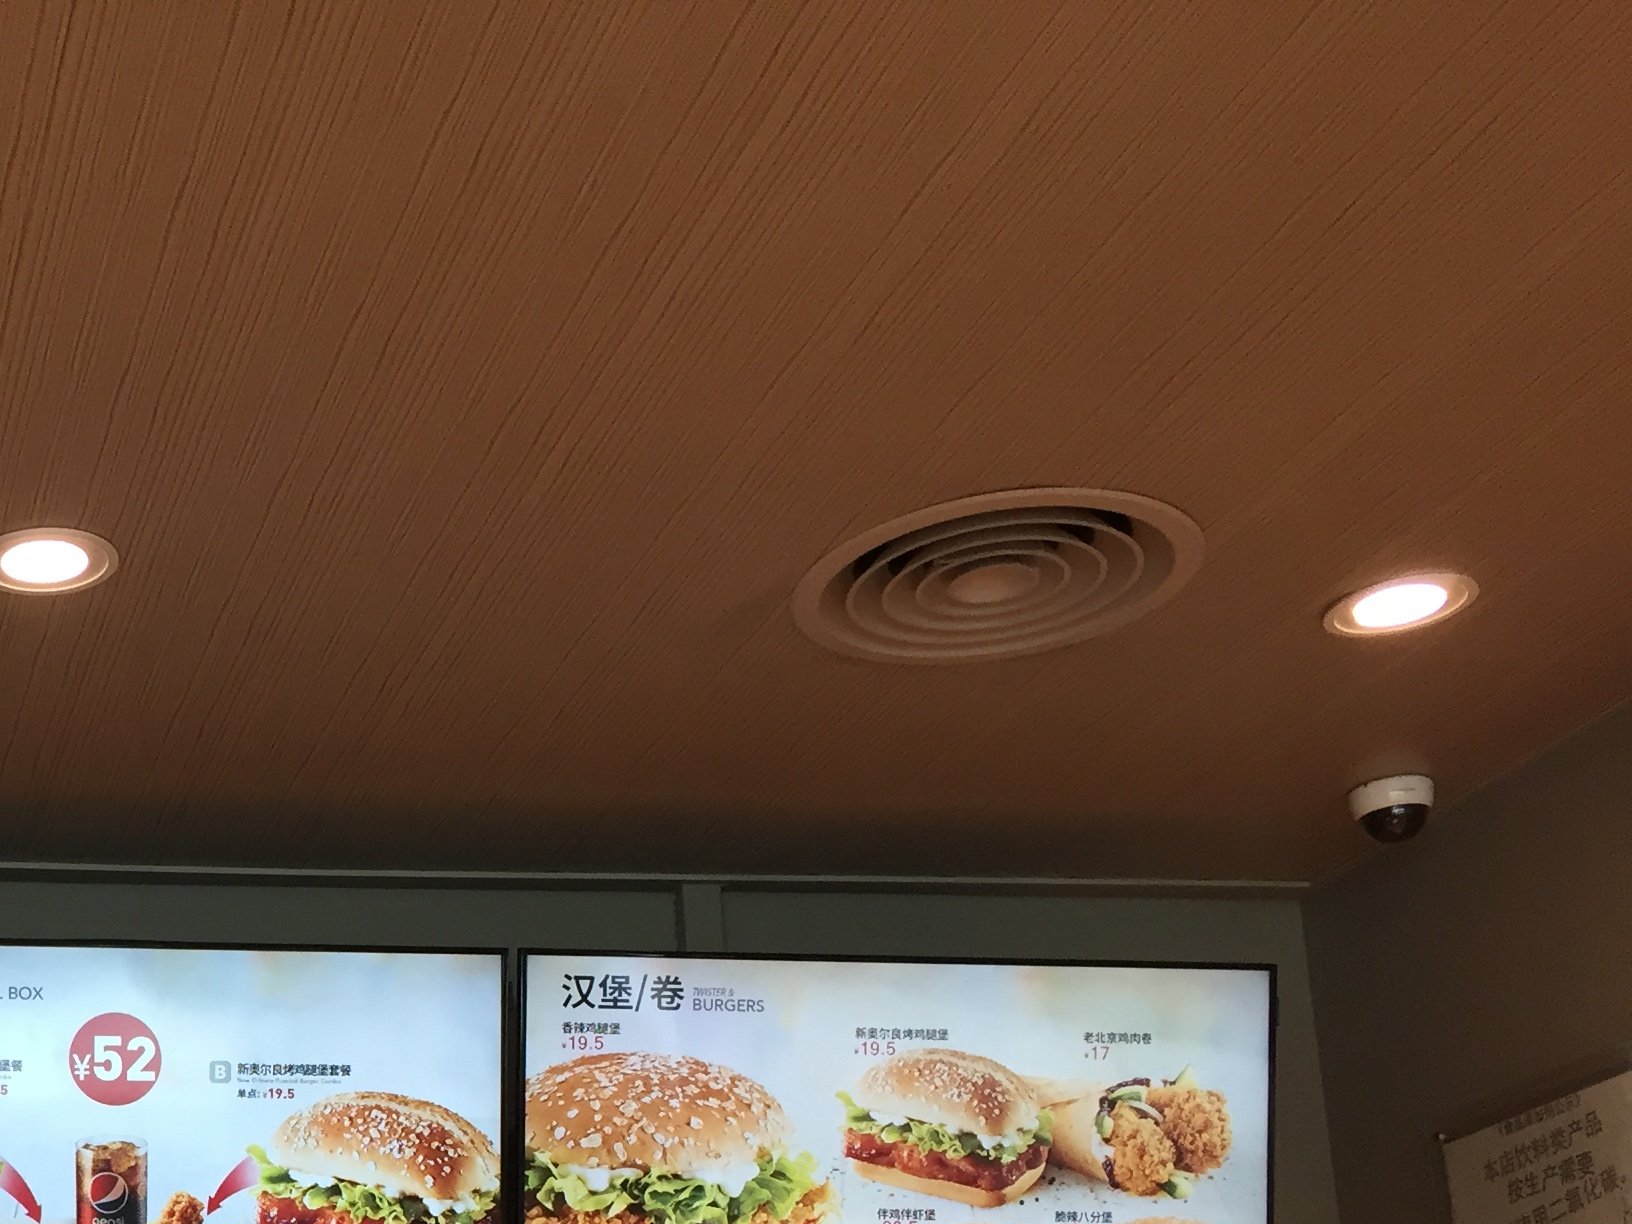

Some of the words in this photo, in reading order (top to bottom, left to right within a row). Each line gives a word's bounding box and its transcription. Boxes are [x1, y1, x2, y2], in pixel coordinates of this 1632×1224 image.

[8, 986, 44, 1001] BOX
[562, 973, 685, 1012] 汉堡/卷
[692, 998, 766, 1013] BURGERS
[561, 1021, 621, 1035] 香辣鸡腿堡
[855, 1026, 949, 1041] 新奥尔良烤鸡腿堡
[1083, 1031, 1152, 1045] 老北京鸡肉卷
[72, 1034, 157, 1082] ¥52
[214, 1064, 226, 1080] B
